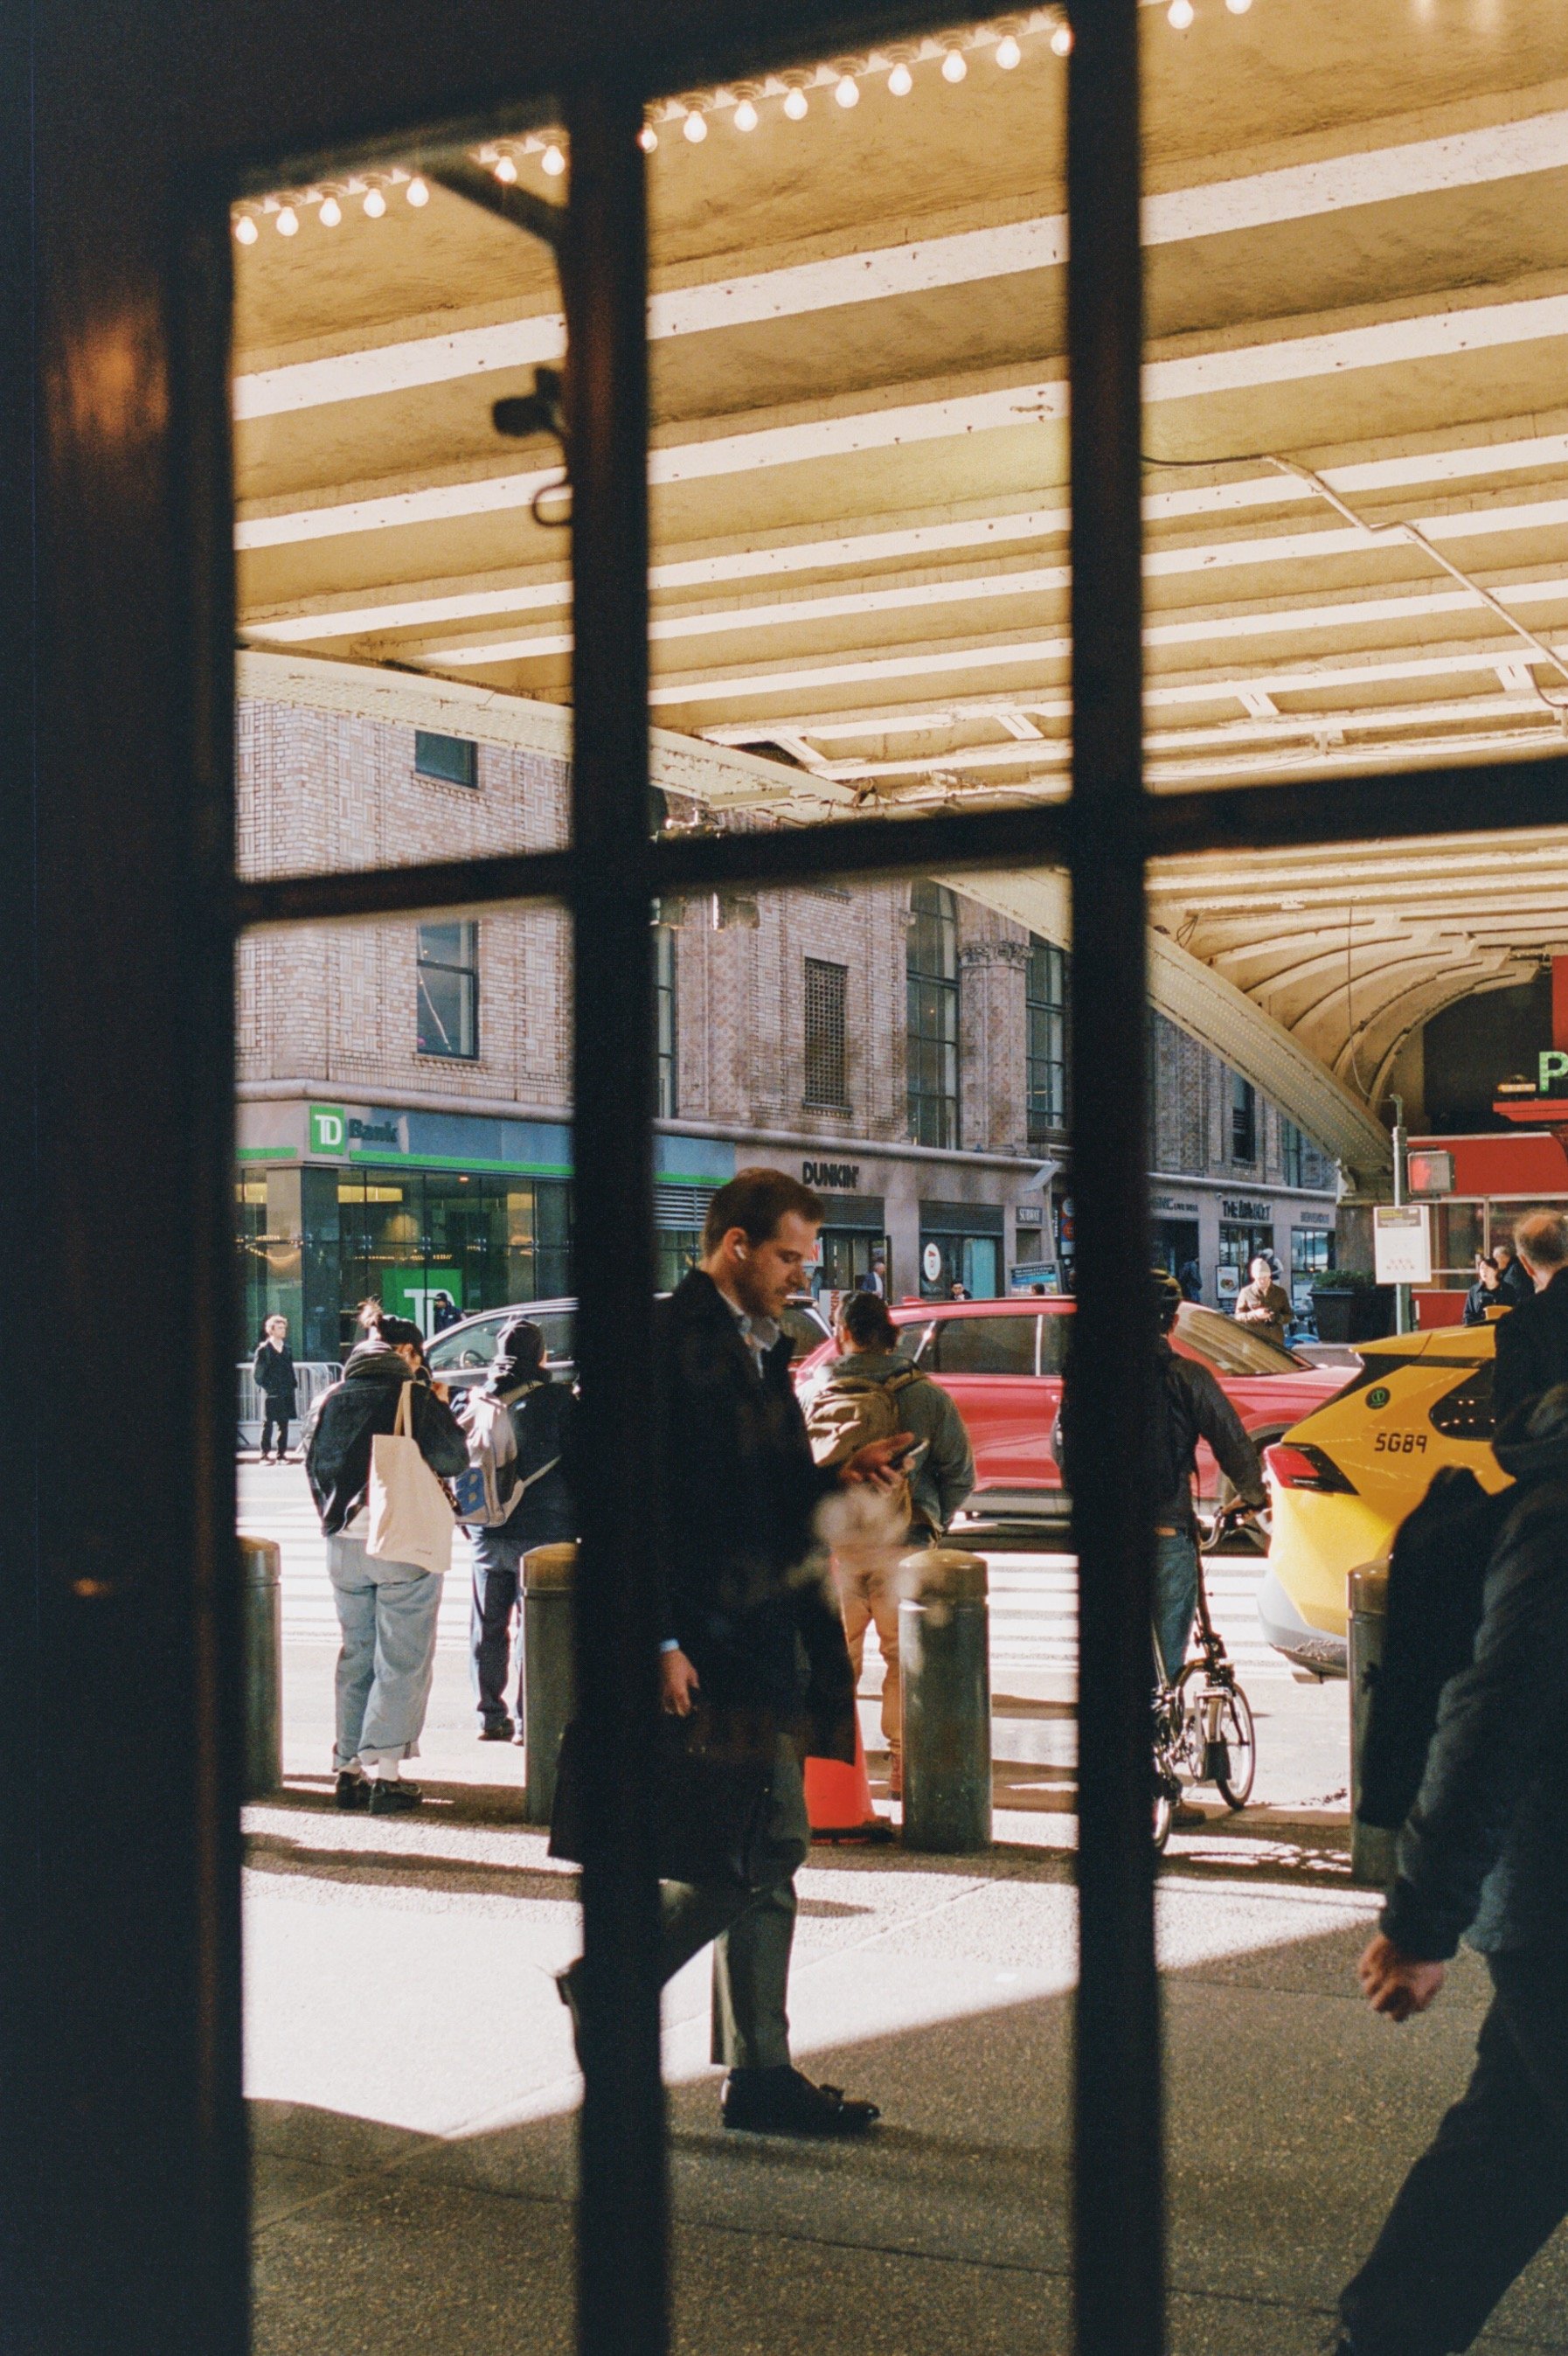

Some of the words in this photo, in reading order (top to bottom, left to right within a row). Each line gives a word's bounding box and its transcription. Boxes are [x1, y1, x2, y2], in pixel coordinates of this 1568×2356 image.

[315, 1114, 343, 1145] TD
[349, 1118, 398, 1143] Bank
[1019, 1209, 1040, 1222] SUBWAY
